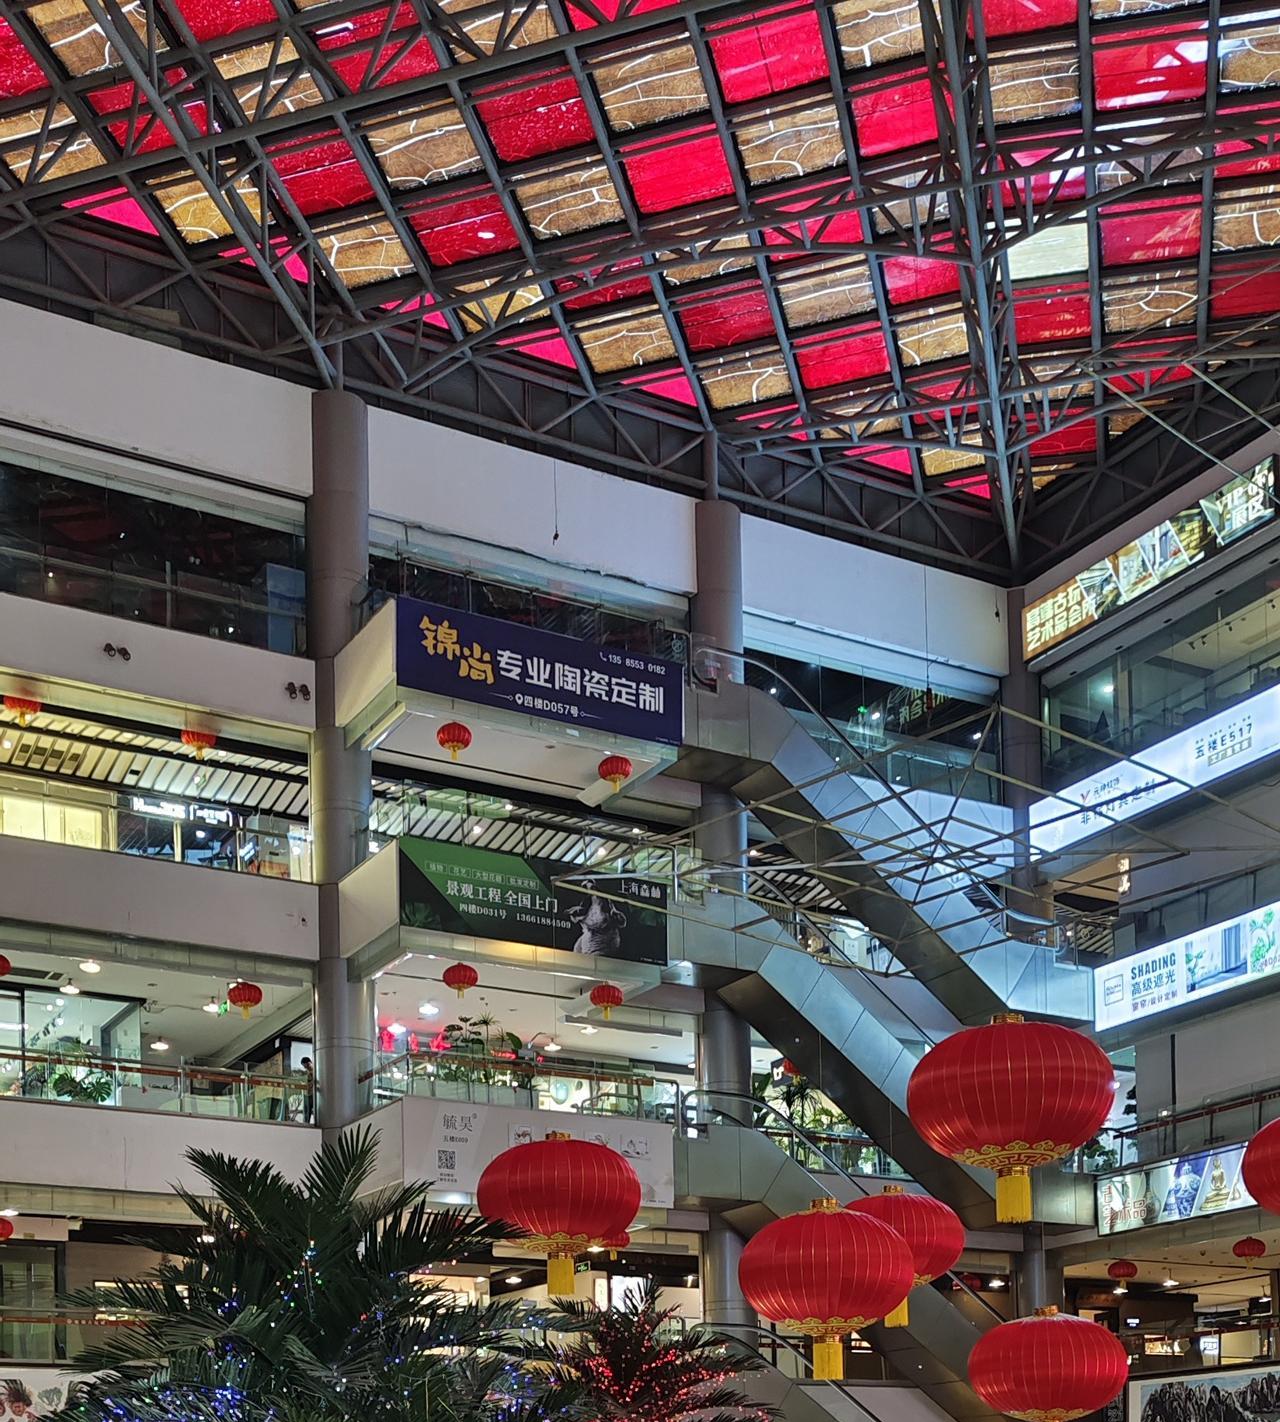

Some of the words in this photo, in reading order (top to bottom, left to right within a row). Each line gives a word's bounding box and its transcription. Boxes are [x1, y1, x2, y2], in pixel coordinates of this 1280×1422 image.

[419, 615, 494, 685] 锦尚
[608, 654, 622, 665] 135
[626, 658, 644, 670] 8553
[647, 662, 666, 675] 0182
[497, 649, 664, 714] 专业陶瓷定制
[524, 695, 579, 718] 四楼D057号
[446, 880, 502, 903] 景观工程
[504, 890, 558, 913] 全国上门
[1131, 952, 1176, 980] SHADING
